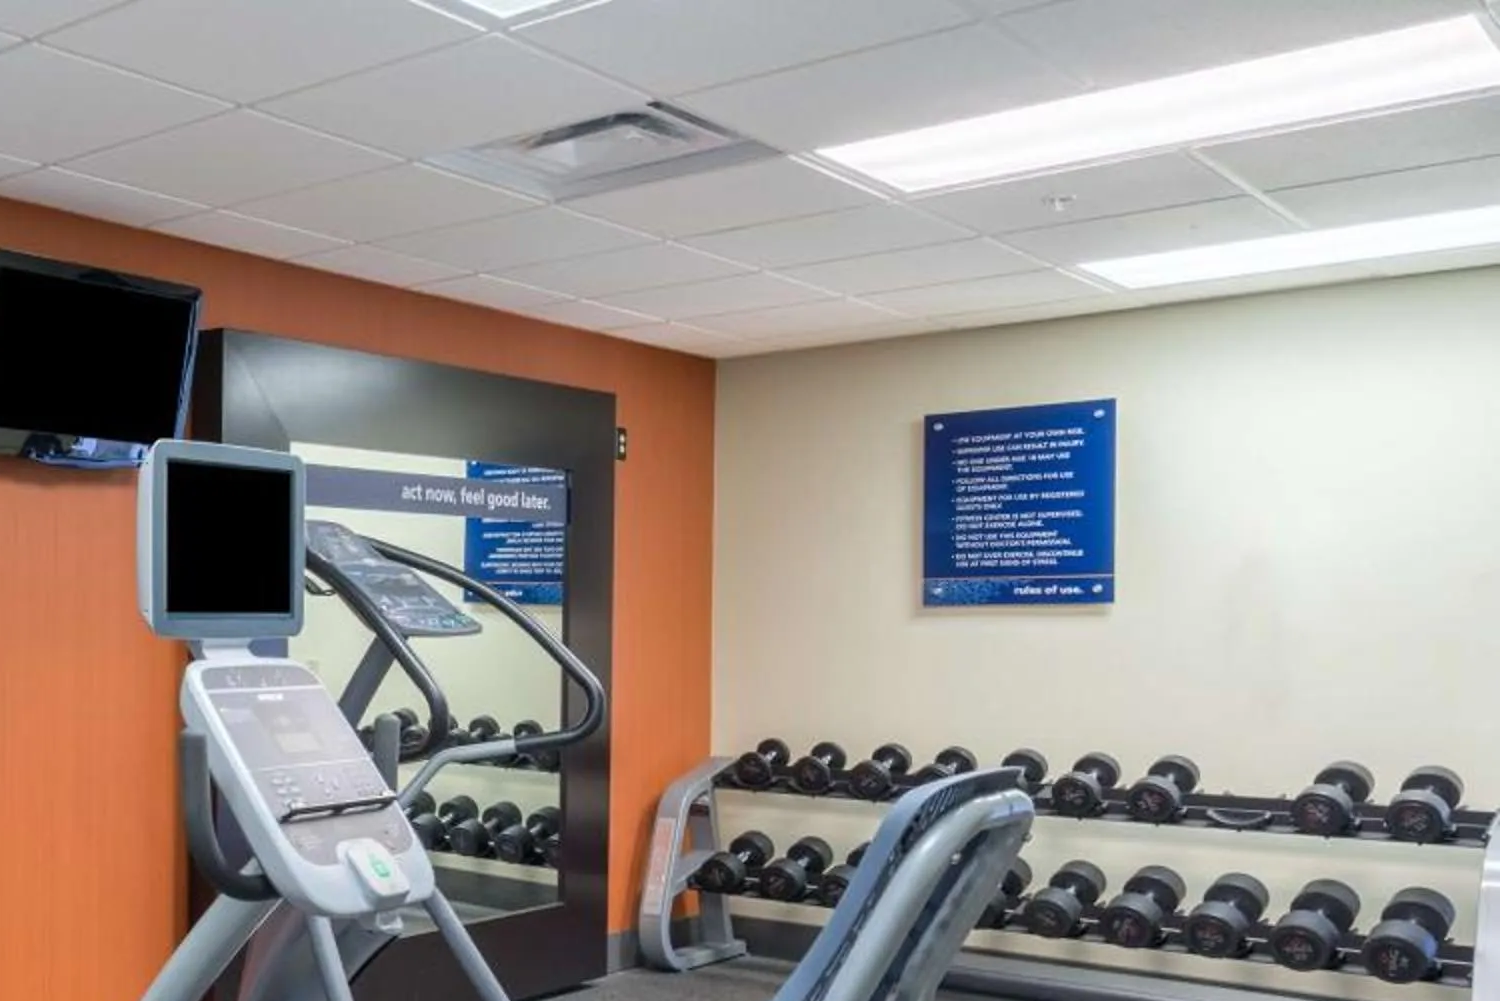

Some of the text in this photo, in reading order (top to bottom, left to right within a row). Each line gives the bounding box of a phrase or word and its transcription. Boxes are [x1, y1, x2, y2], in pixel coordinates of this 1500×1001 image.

[402, 485, 551, 511] act now, feel good later.
[1044, 584, 1057, 595] of
